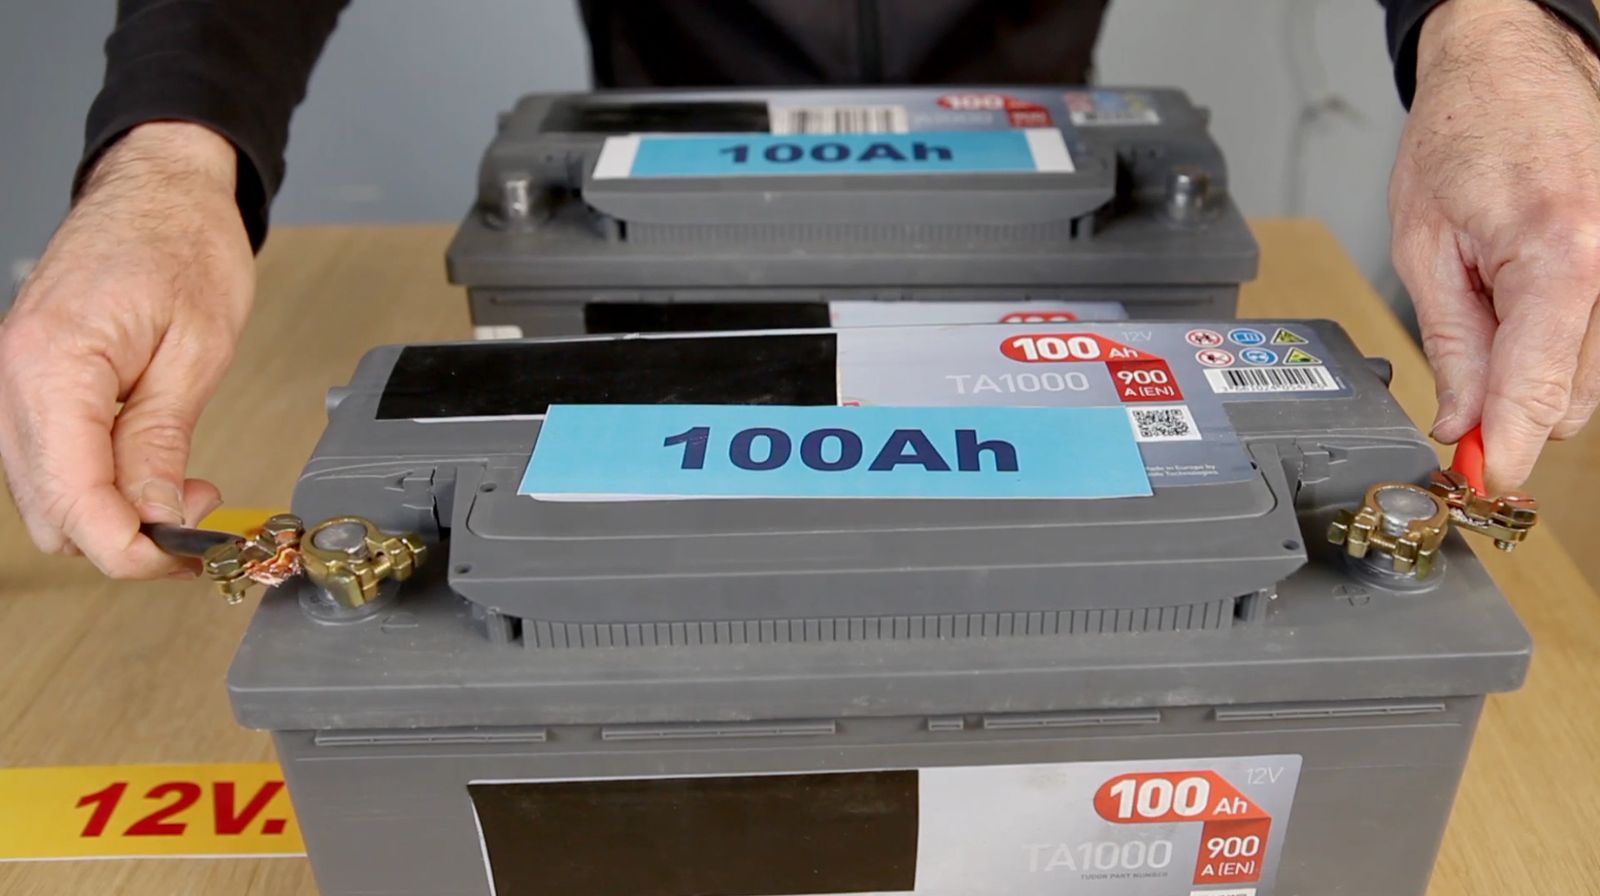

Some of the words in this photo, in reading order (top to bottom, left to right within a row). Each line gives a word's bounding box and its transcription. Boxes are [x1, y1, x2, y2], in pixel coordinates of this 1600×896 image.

[719, 142, 954, 164] 100Ah
[1122, 331, 1152, 342] 12V
[1013, 336, 1100, 361] 100
[1108, 347, 1138, 359] Ah
[945, 372, 1090, 394] TA1000
[1117, 369, 1168, 385] 900
[1124, 387, 1137, 397] A
[663, 427, 1019, 472] 100Ah
[1247, 767, 1284, 785] 12V
[75, 780, 288, 837] 12V.
[1110, 777, 1210, 819] 100
[1212, 797, 1248, 816] Ah
[1021, 840, 1173, 872] TA1000
[1206, 835, 1260, 859] 900
[1200, 864, 1215, 876] A
